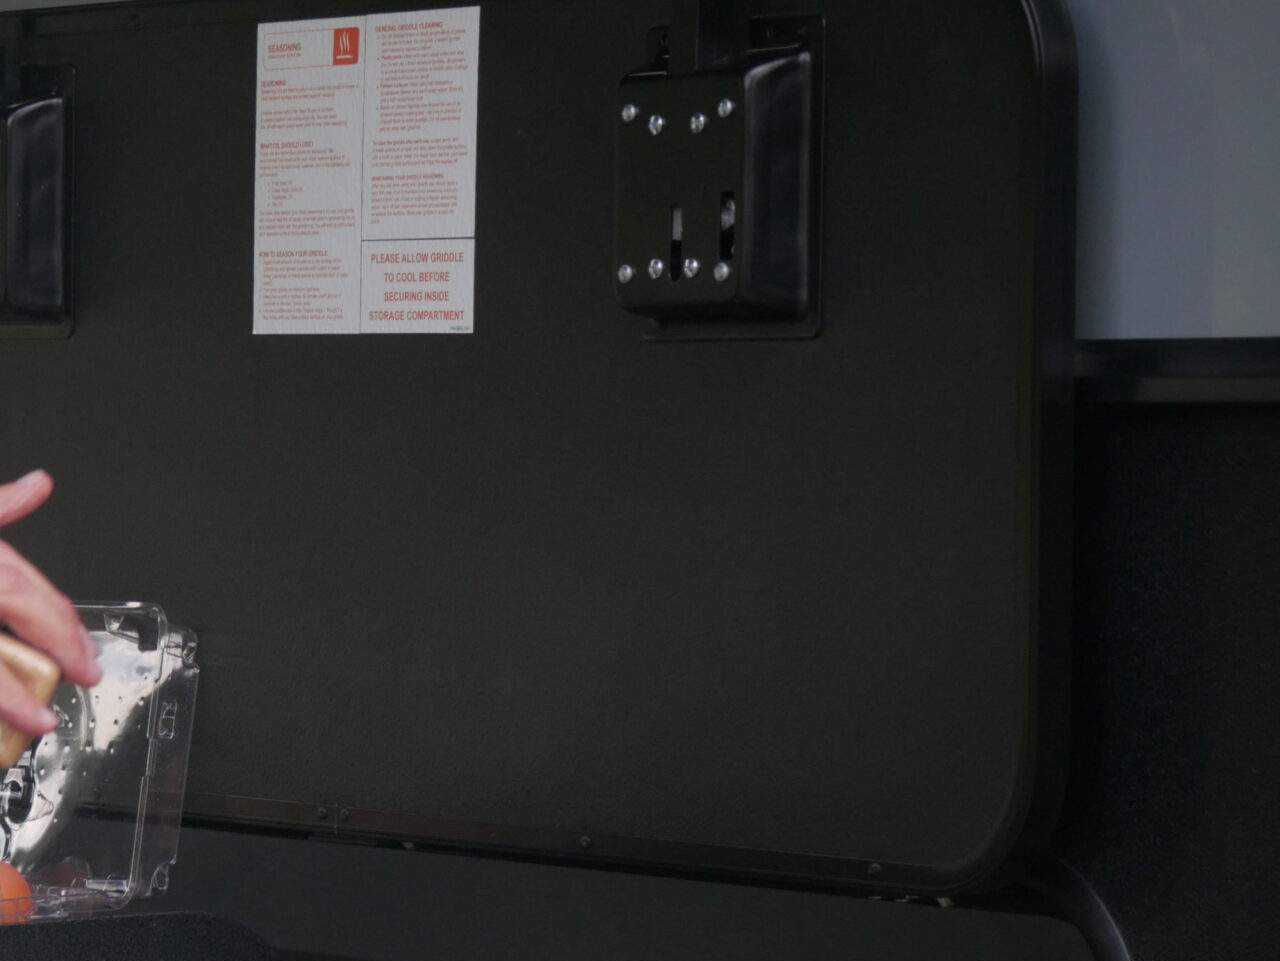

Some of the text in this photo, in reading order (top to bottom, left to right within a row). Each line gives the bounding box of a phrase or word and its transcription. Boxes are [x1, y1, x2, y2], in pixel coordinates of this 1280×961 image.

[267, 43, 302, 53] SEASONING
[370, 251, 464, 264] PLEASE ALLOW GRIDDLE
[384, 271, 450, 282] TO COOL BEFORE
[384, 290, 449, 302] SECURING INSIDE
[369, 310, 464, 321] STORAGE COMPARTMENT
